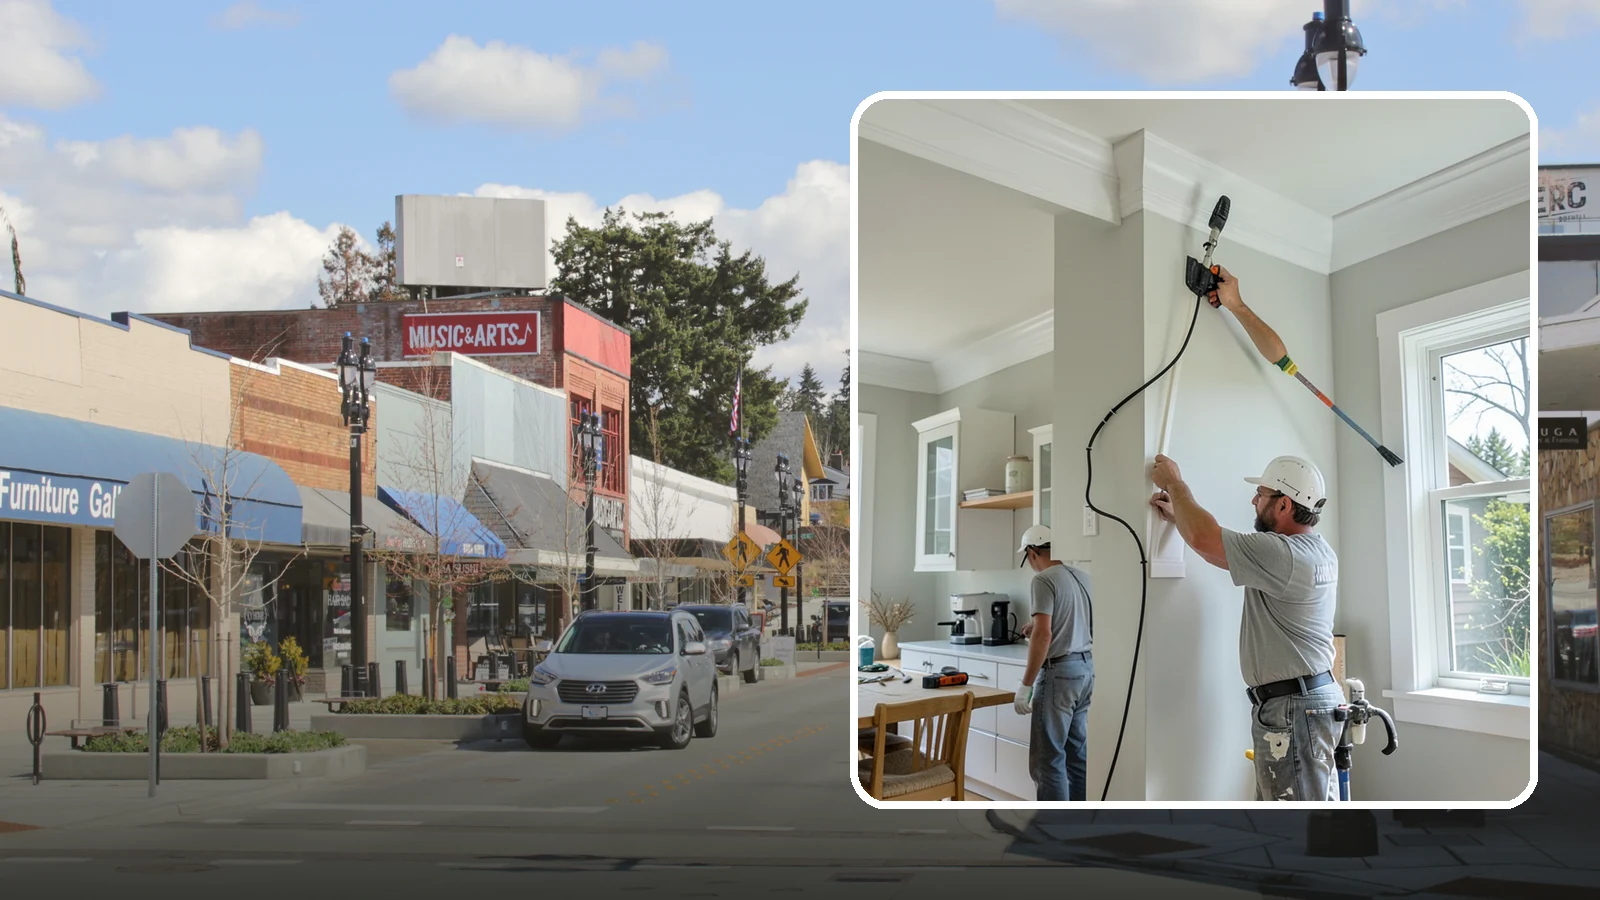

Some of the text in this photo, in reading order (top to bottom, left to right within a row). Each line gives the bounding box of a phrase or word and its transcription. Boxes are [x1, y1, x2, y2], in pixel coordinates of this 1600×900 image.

[0, 471, 121, 519] Furniture Gal
[453, 563, 479, 574] SUSHI
